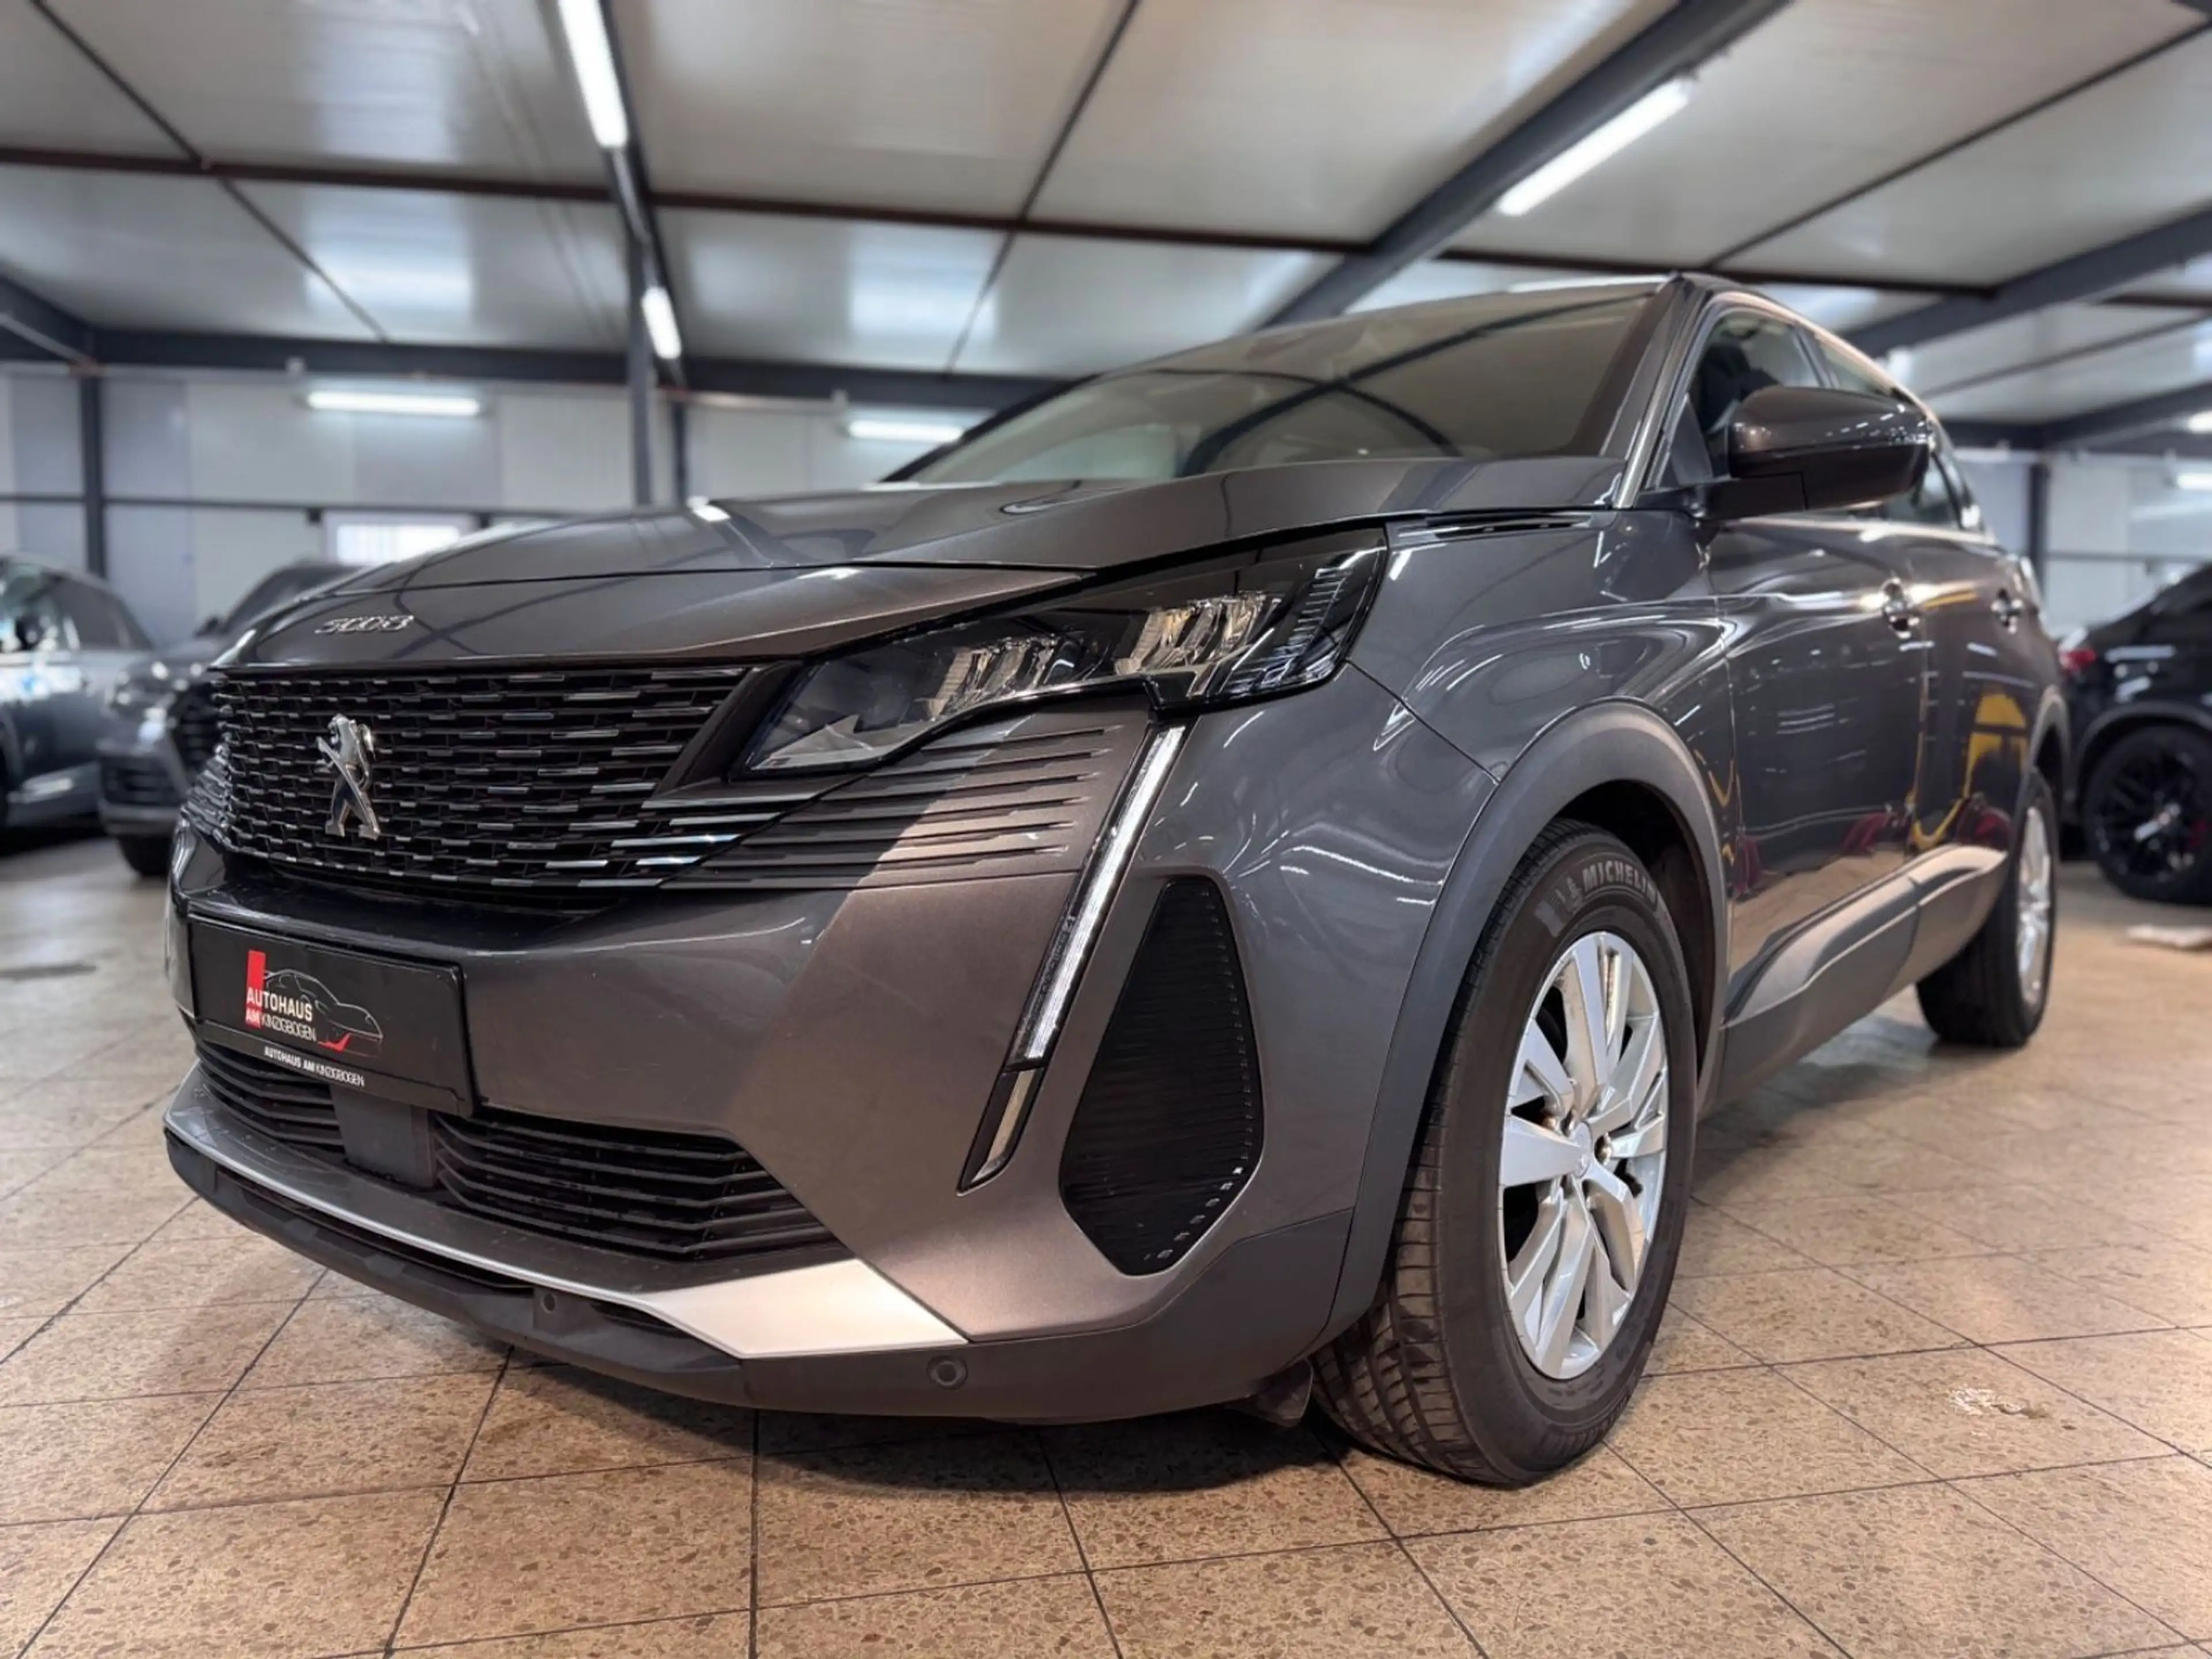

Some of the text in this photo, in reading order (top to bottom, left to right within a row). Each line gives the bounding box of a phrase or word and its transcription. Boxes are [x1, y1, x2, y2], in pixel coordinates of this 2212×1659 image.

[1581, 860, 1659, 906] MICHELIN
[245, 1008, 260, 1026] AM
[246, 987, 313, 1021] AUTOHAUS
[264, 1046, 302, 1069] AUTOHAUS
[303, 1060, 315, 1073] AM
